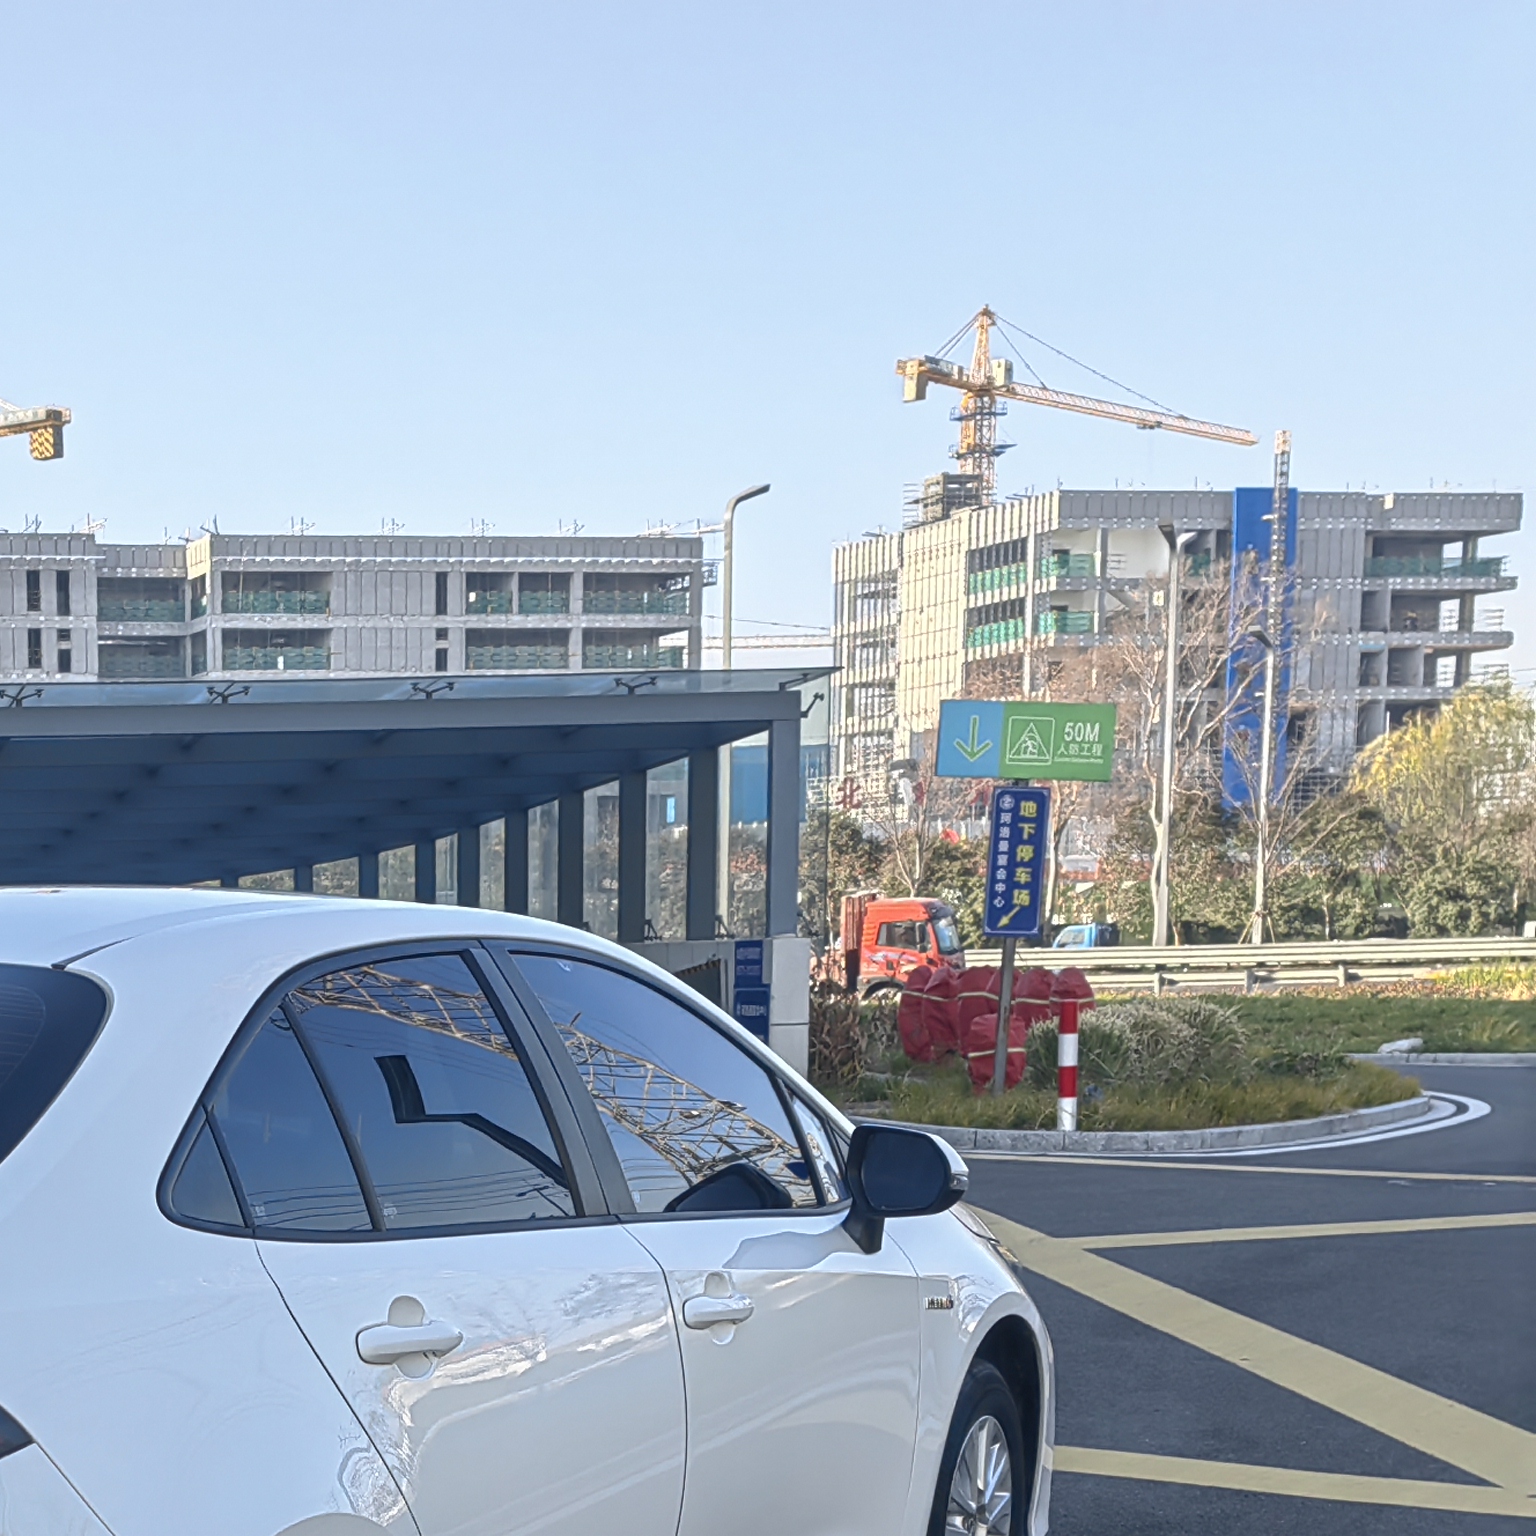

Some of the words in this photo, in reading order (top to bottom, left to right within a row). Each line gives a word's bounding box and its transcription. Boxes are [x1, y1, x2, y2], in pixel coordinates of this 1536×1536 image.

[1064, 722, 1100, 742] 50M
[1012, 801, 1037, 906] 地下停车场
